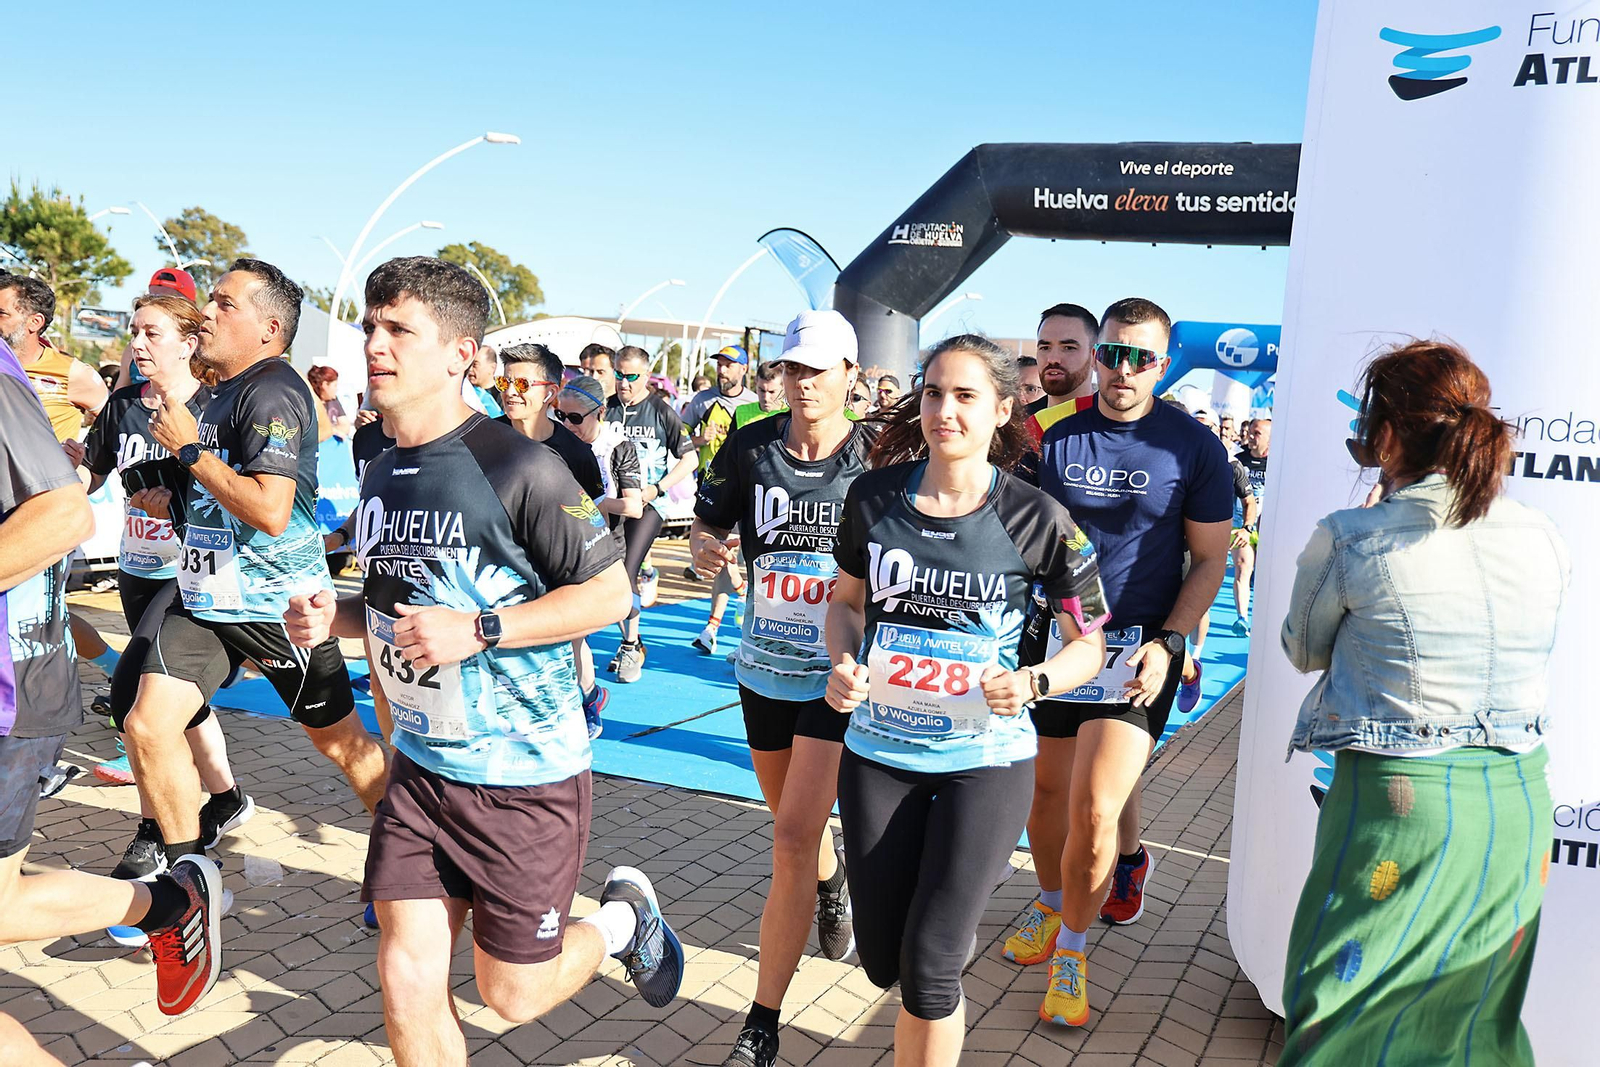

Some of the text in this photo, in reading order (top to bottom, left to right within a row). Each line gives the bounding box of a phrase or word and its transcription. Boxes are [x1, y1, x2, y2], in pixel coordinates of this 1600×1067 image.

[1119, 160, 1234, 179] Vive el deporte
[1033, 187, 1109, 210] Huelva
[1114, 187, 1169, 212] eleva
[1175, 190, 1211, 212] tus
[924, 231, 963, 242] HUELVA
[1064, 463, 1150, 489] COPO
[754, 483, 845, 545] 10 HUEL
[127, 516, 175, 541] 1023
[356, 495, 467, 578] 10 HUELVA
[788, 523, 808, 533] PUERTA
[809, 525, 819, 534] DEL
[380, 544, 401, 555] PUERTA
[774, 555, 797, 565] HUELVA
[180, 546, 217, 576] 931
[867, 541, 1007, 613] 10 HUELVA
[911, 593, 936, 604] PUERTA
[936, 595, 949, 606] DEL
[768, 620, 812, 636] Wayalia
[923, 637, 963, 651] AVATEL
[380, 643, 441, 690] 432
[1105, 646, 1124, 670] 7
[887, 654, 970, 696] 228
[305, 701, 327, 710] SPORT
[888, 707, 943, 726] Wayalia
